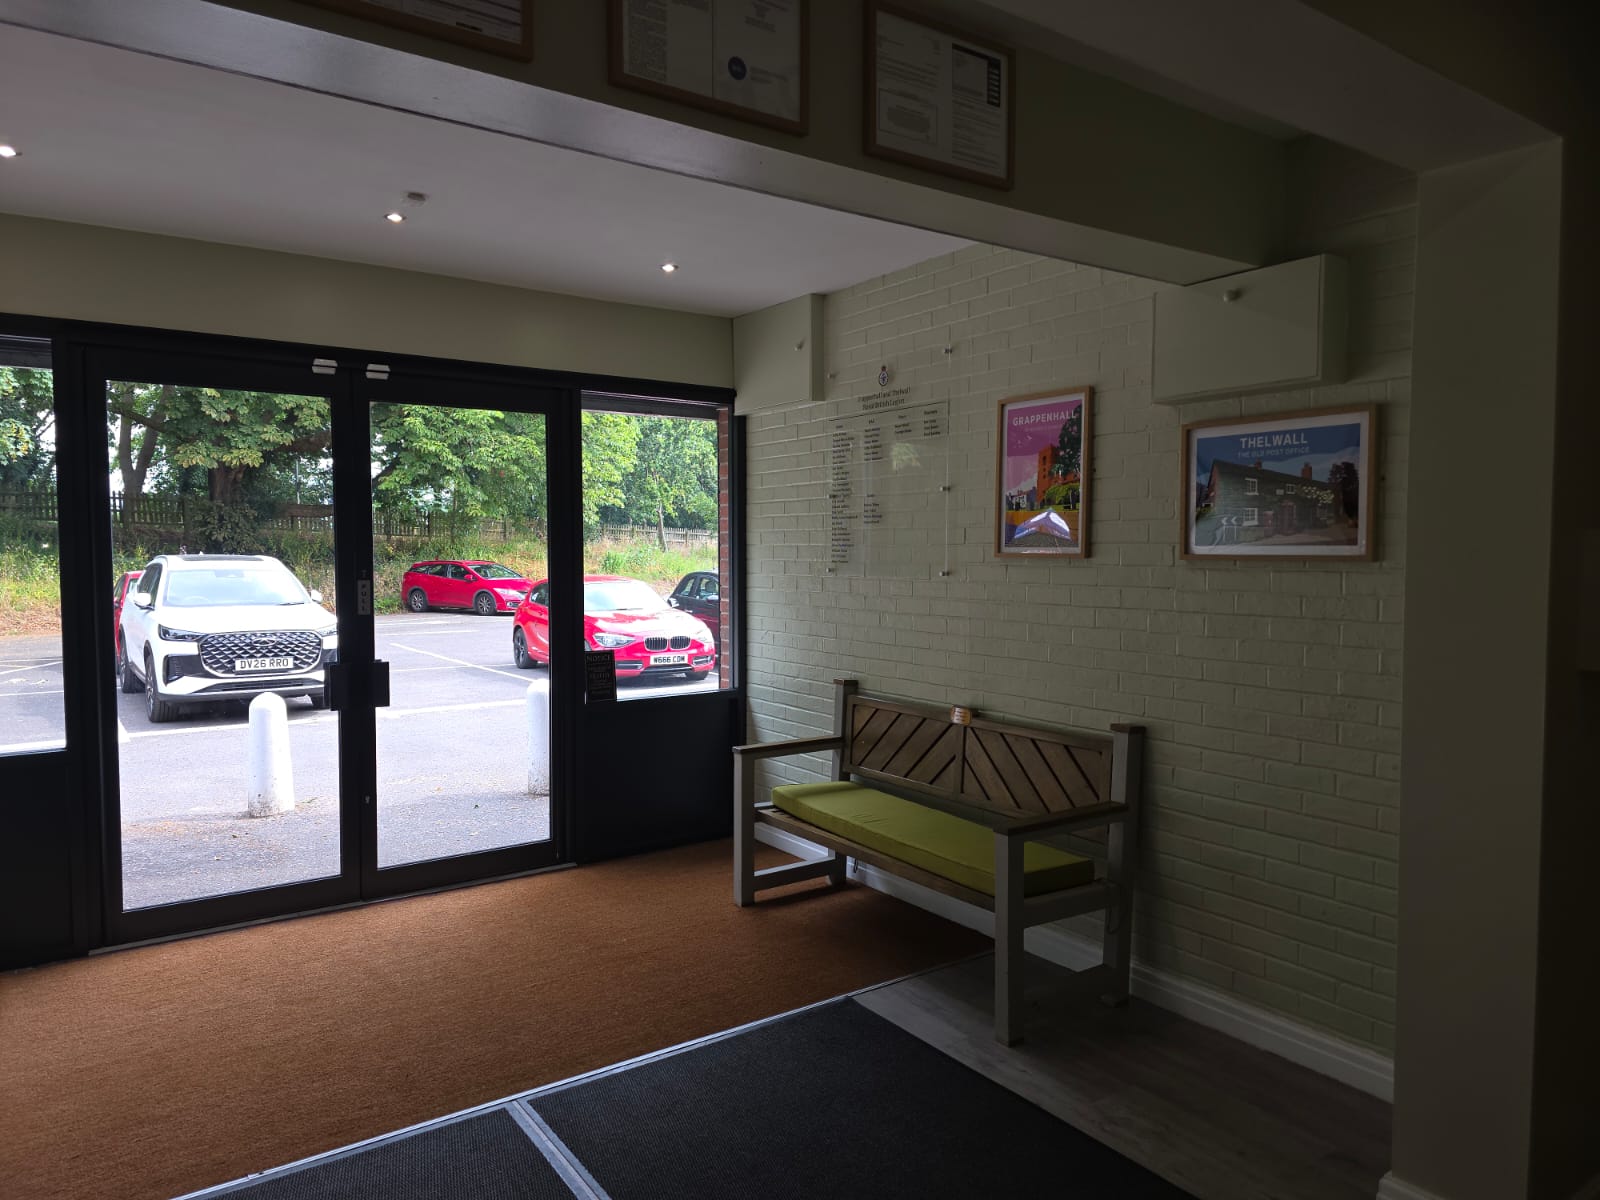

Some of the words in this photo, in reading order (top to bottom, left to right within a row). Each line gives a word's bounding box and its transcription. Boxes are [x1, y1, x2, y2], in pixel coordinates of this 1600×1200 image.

[1012, 409, 1077, 426] GRAPPENHALL
[1239, 432, 1308, 449] THELWALL
[1266, 448, 1283, 457] POST
[1285, 446, 1310, 455] OFFICE
[240, 659, 266, 669] DV26
